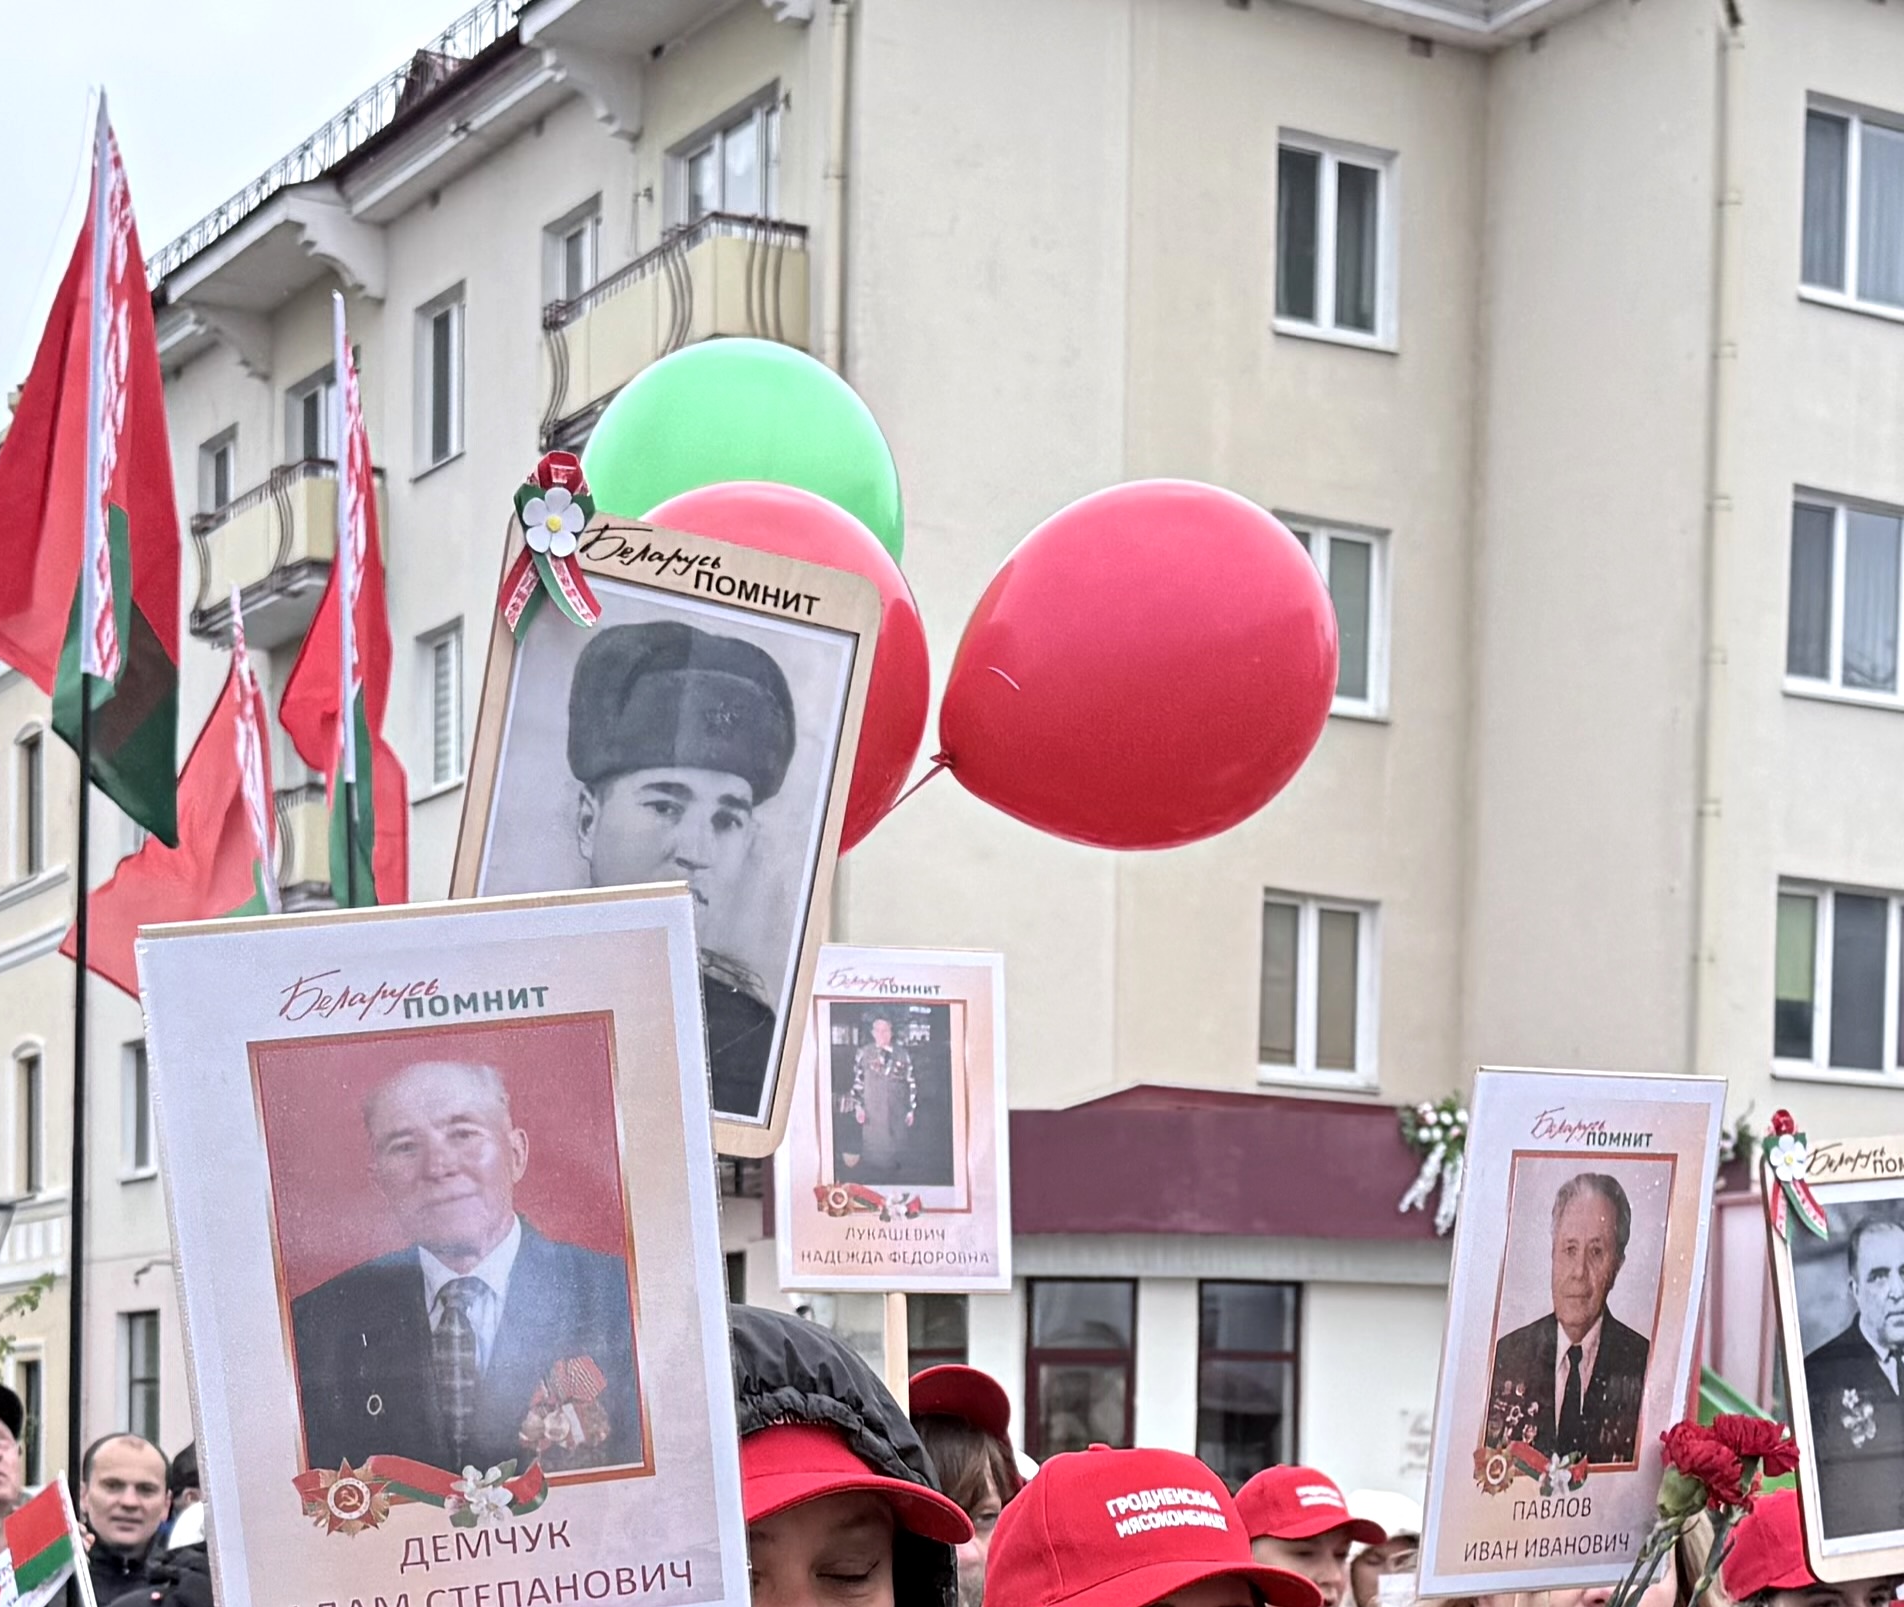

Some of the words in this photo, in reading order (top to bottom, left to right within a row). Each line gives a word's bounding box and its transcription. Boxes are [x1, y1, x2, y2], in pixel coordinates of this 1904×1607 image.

[579, 523, 723, 577] Беларусь
[693, 568, 822, 616] ПОМНИТ
[278, 968, 440, 1022] Беларусь
[402, 985, 549, 1020] ПОМНИТ
[878, 983, 942, 997] ПОМНИТ
[1586, 1131, 1653, 1148] ПОМНИТ
[800, 1250, 884, 1267] НАДЕЖДА
[1512, 1496, 1592, 1521] ПАВЛОВ
[399, 1519, 572, 1575] ДЕМЧУК
[1463, 1539, 1519, 1563] ИВАН
[1524, 1532, 1630, 1559] ИВАНОВИЧ
